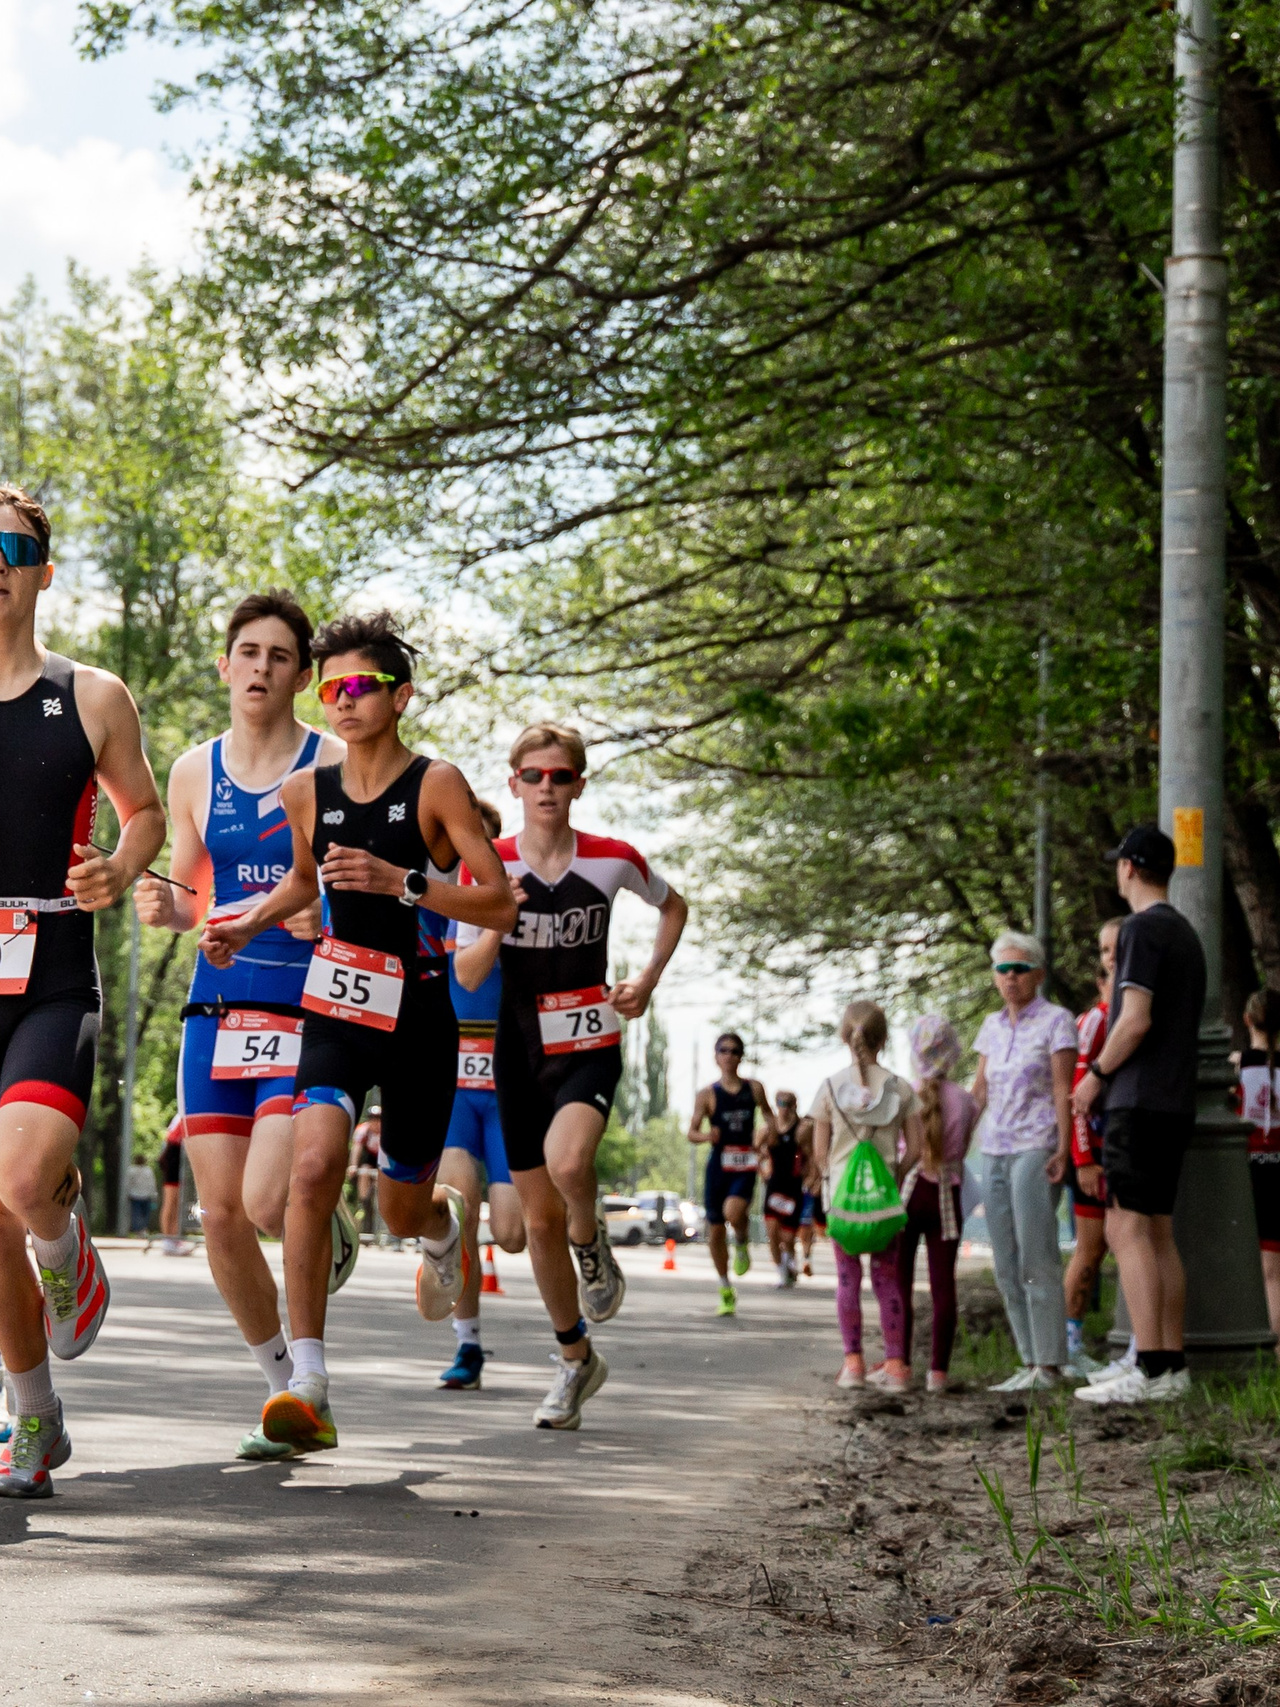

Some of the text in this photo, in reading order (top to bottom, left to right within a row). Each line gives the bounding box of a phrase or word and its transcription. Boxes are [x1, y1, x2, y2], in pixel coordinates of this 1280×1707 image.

[237, 863, 287, 883] RUS
[328, 968, 371, 1005] 55
[566, 1008, 603, 1037] 78
[241, 1035, 281, 1062] 54
[464, 1056, 490, 1076] 62
